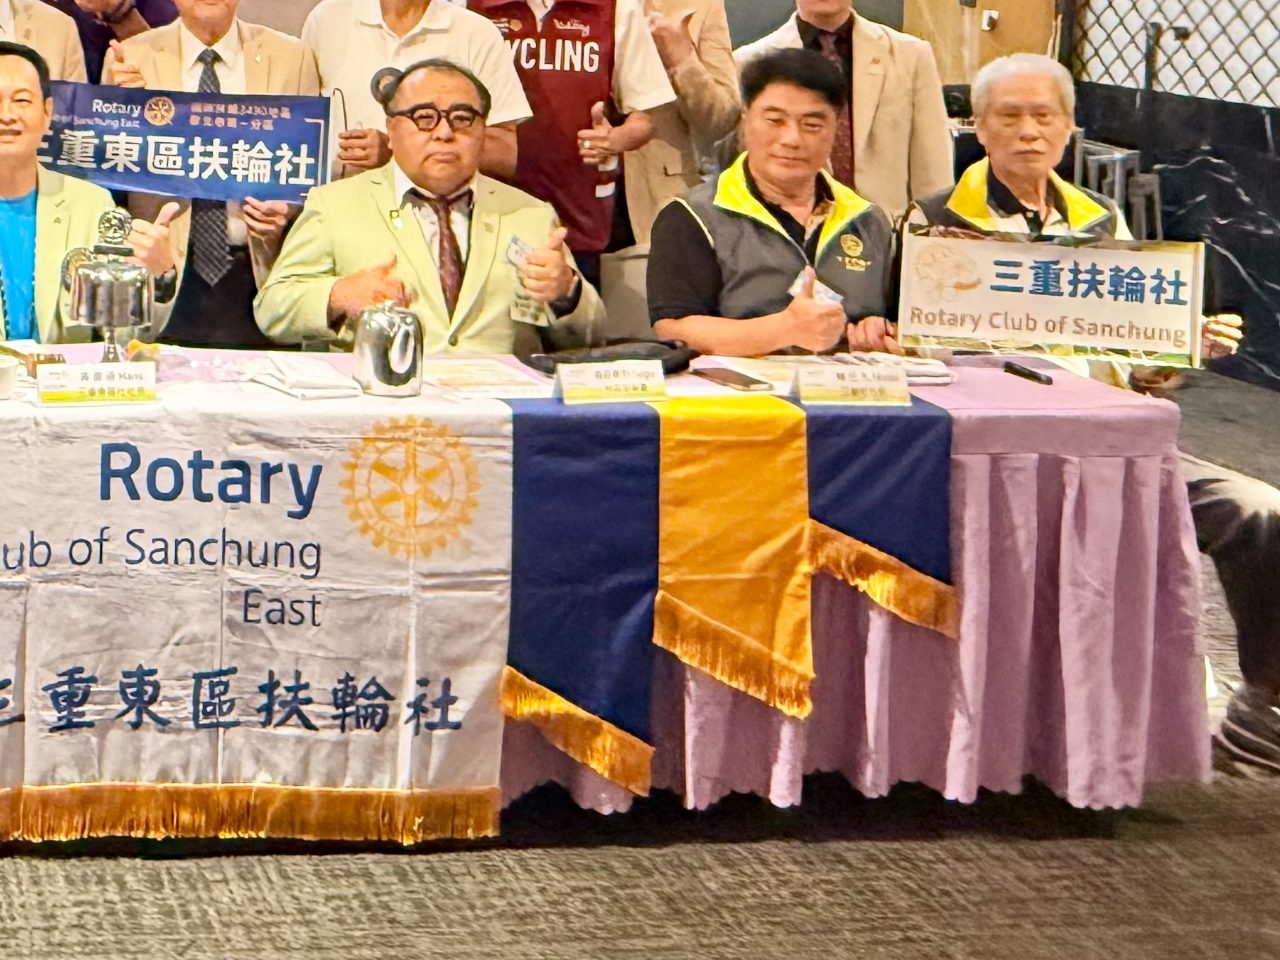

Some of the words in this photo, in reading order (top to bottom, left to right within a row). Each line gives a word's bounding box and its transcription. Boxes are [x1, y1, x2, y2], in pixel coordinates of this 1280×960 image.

[92, 98, 142, 118] Rotary
[989, 258, 1189, 307] 三重扶輪社
[910, 306, 982, 332] Rotary
[988, 311, 1038, 332] Club
[1044, 315, 1069, 334] of
[1073, 316, 1187, 348] Sanchung
[99, 441, 323, 520] Rotary
[68, 526, 111, 566] of
[124, 526, 322, 578] Sanchung
[242, 588, 323, 628] East
